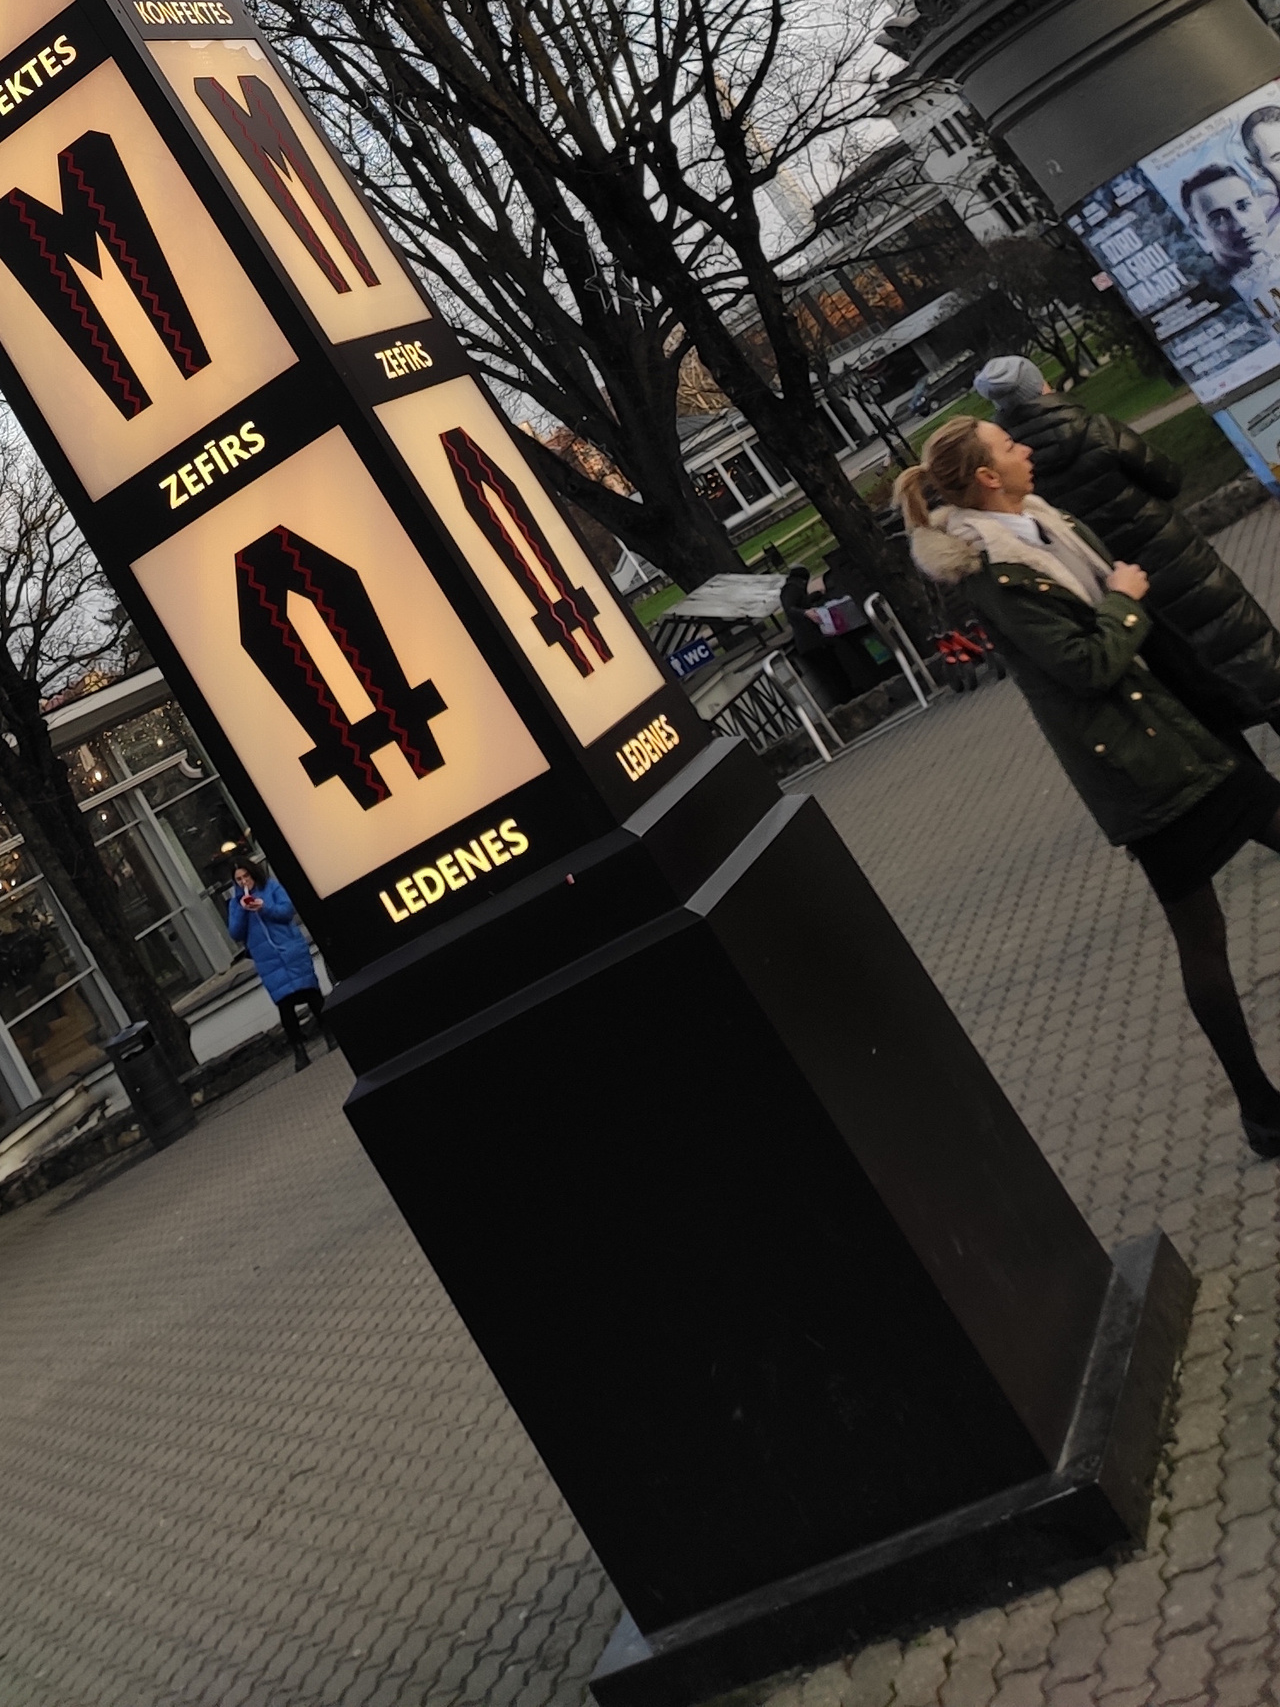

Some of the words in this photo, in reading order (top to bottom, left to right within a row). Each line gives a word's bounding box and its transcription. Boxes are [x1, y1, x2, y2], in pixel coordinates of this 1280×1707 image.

[134, 0, 234, 26] KONFEKTES
[374, 341, 434, 379] ZEFĪRS
[159, 420, 266, 509] ZEFĪRS
[683, 644, 710, 666] WC
[615, 714, 681, 782] LEDENES
[379, 818, 529, 923] LEDENES
